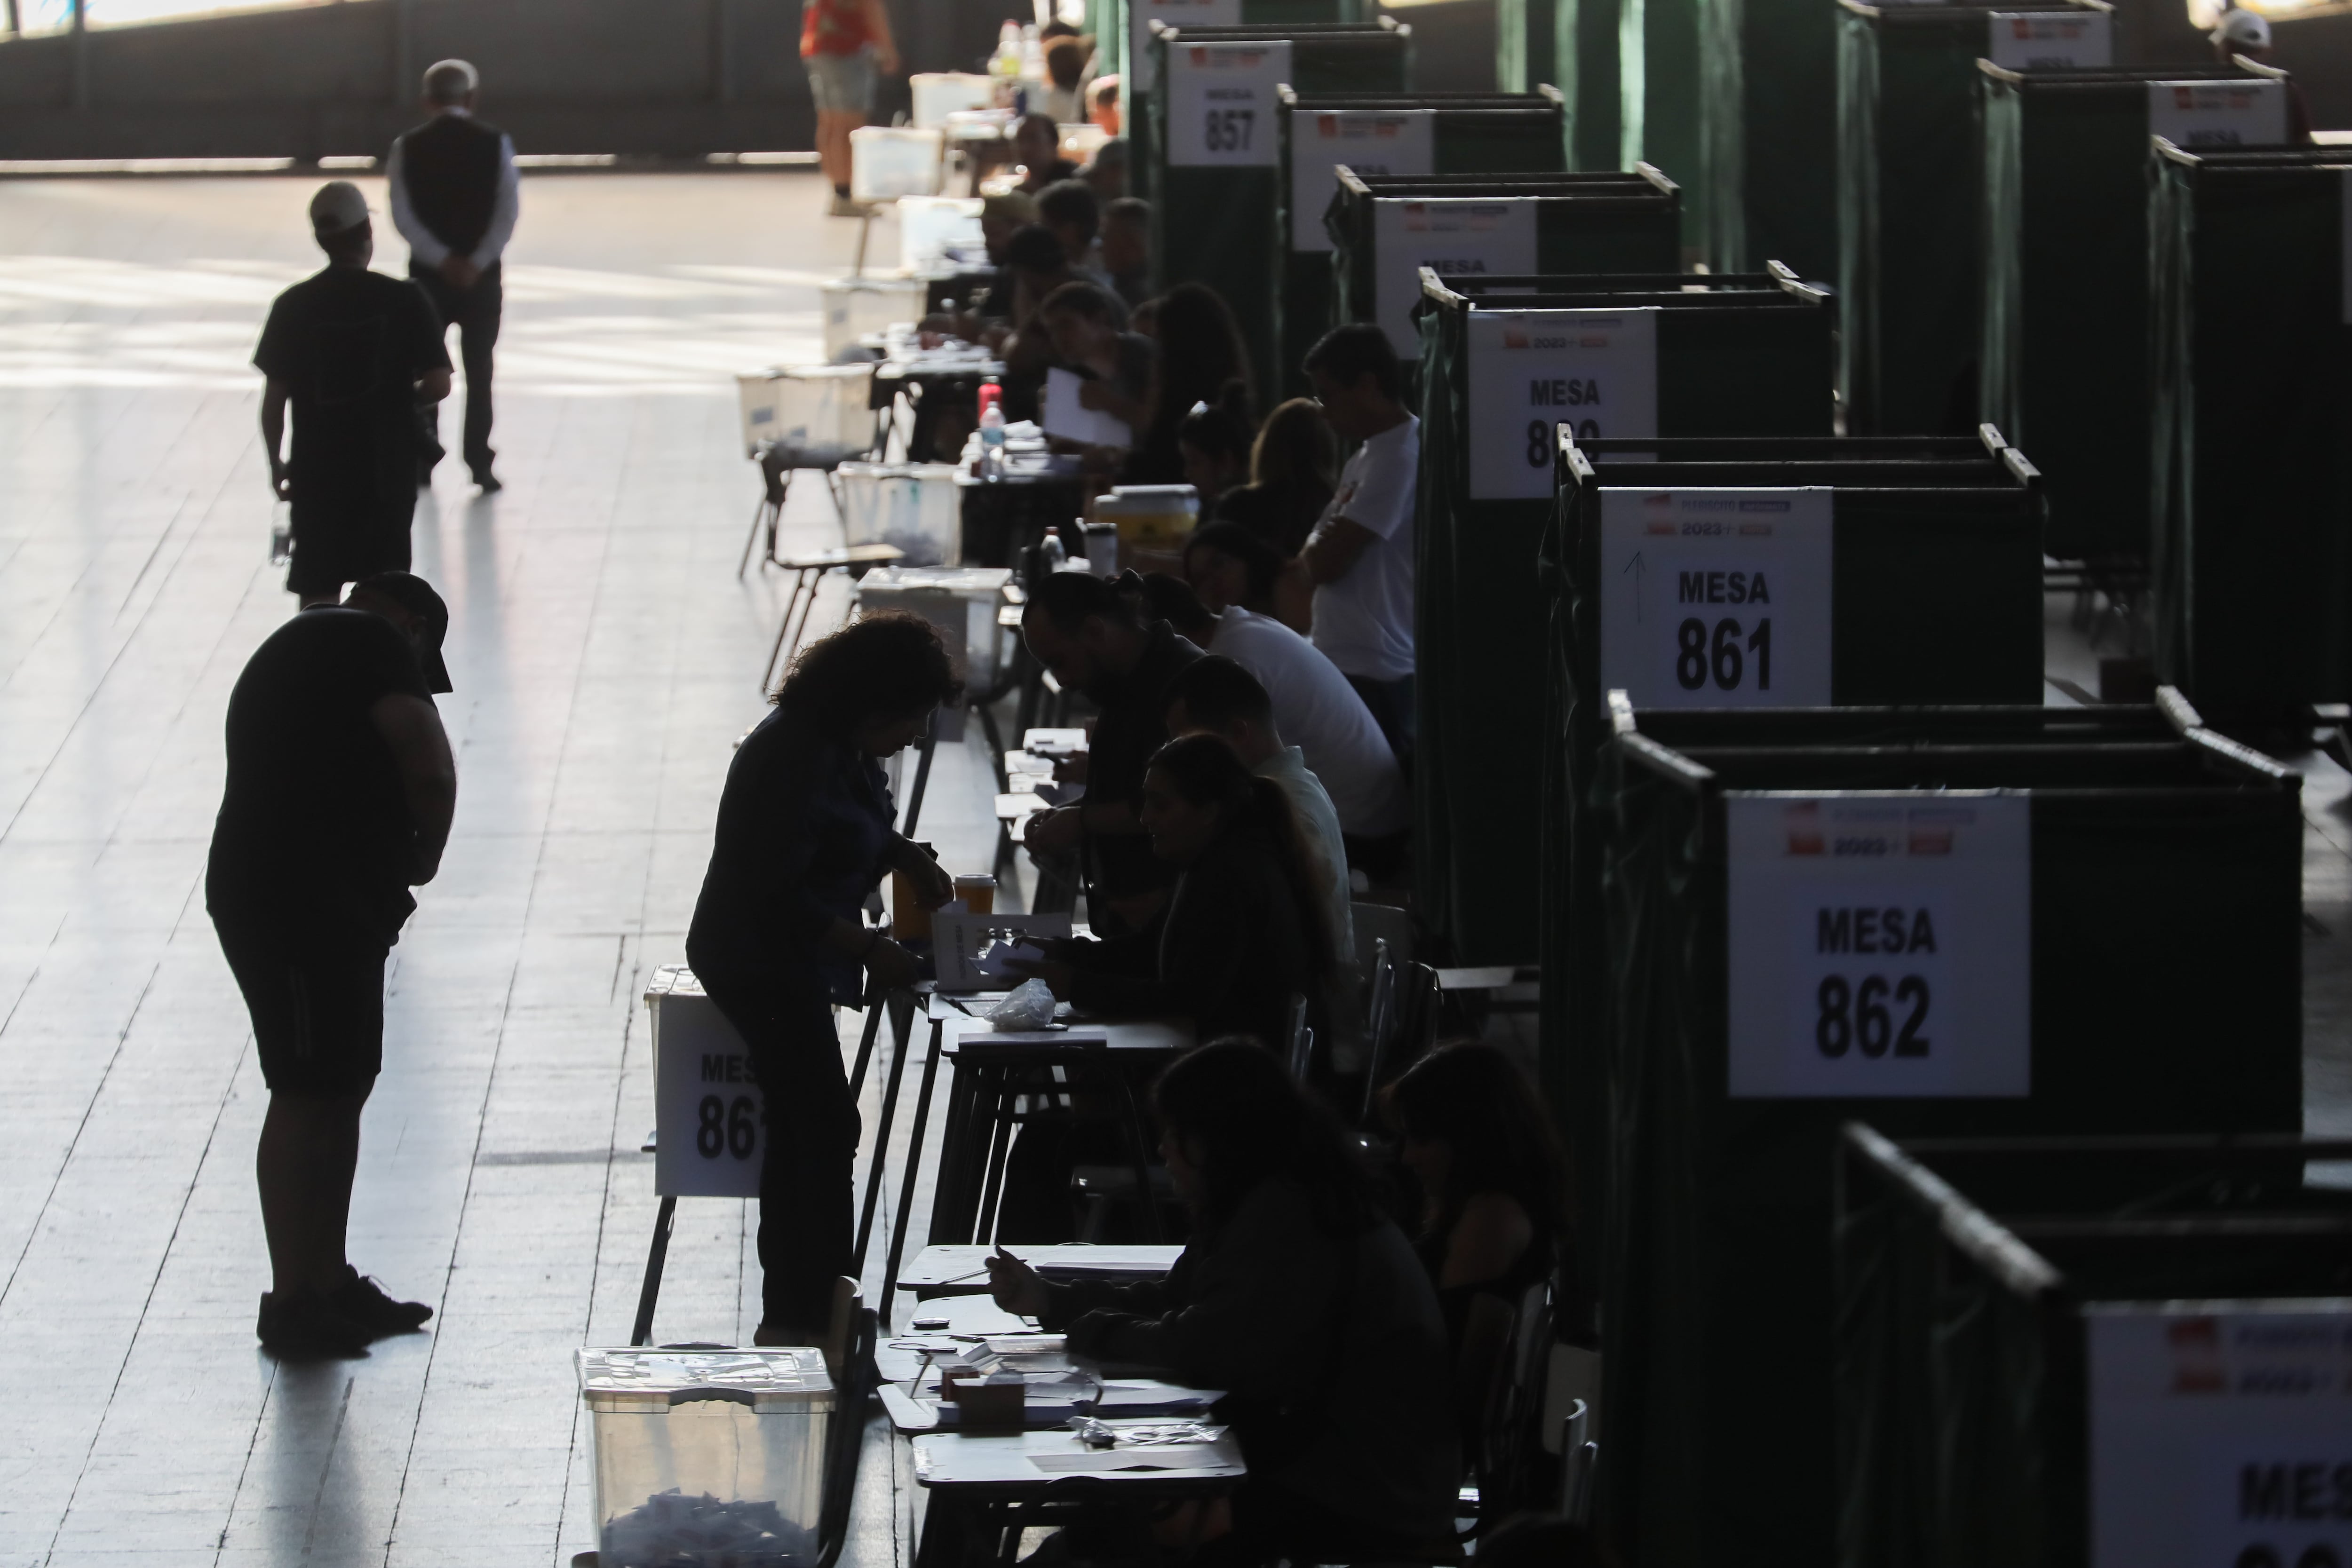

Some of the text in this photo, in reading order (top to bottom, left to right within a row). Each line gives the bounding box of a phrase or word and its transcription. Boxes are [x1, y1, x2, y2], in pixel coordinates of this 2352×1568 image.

[1205, 109, 1255, 151] 857
[1530, 380, 1600, 406] MESA
[1678, 571, 1770, 604] MESA
[1676, 617, 1771, 691] 861
[1817, 907, 1937, 954] MESA
[1816, 974, 1930, 1059] 862
[701, 1054, 758, 1083] MES
[697, 1094, 767, 1160] 86
